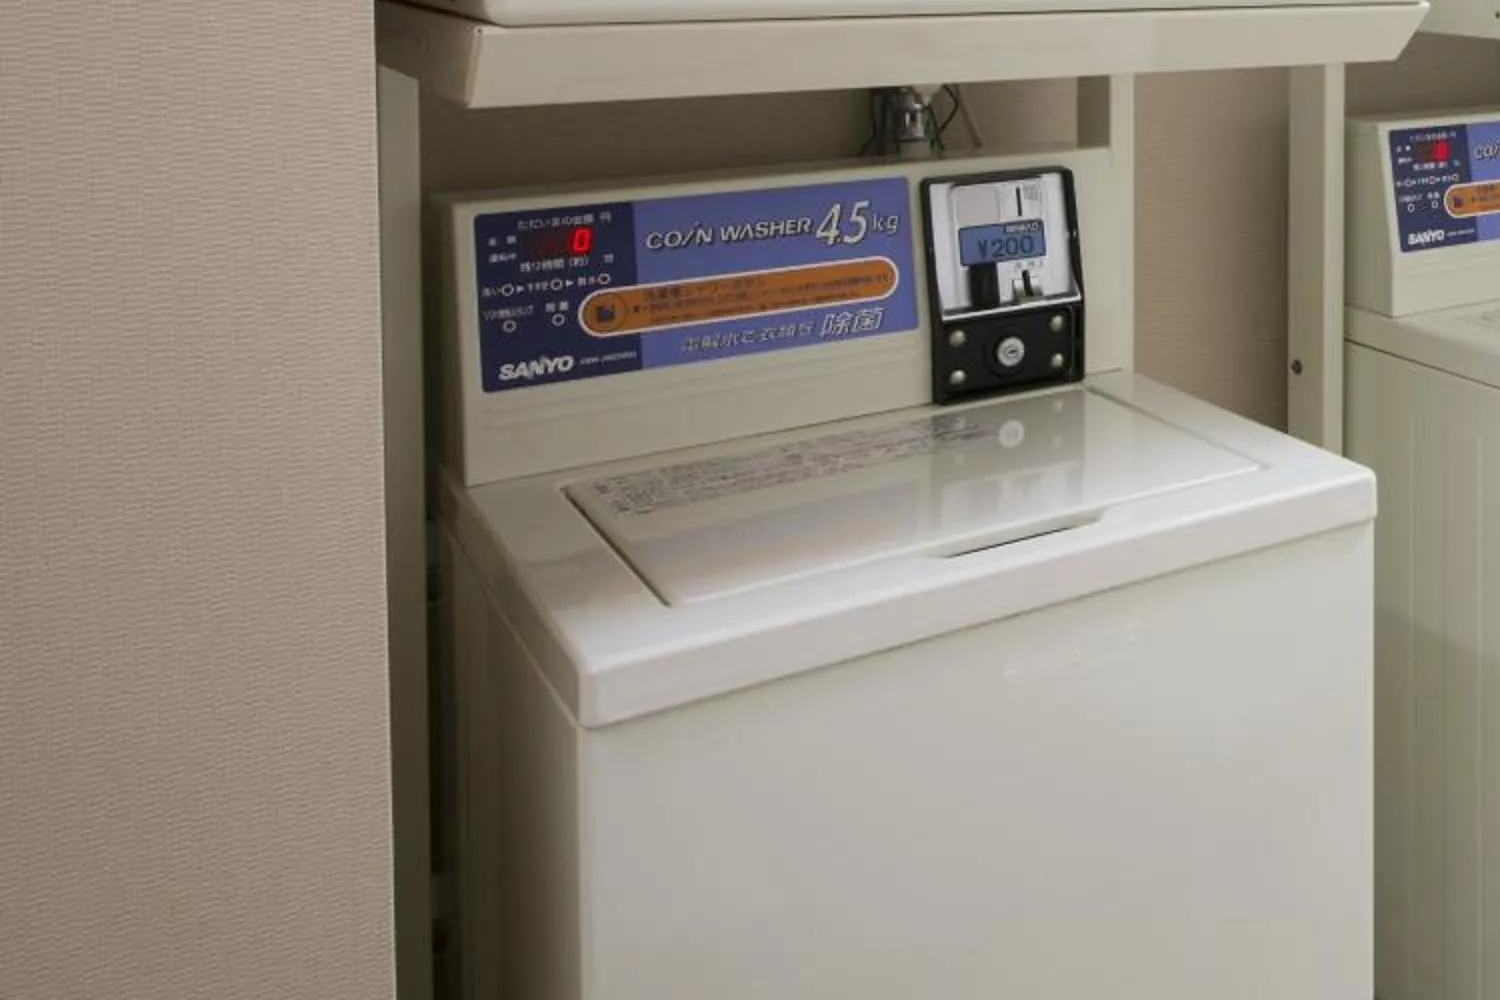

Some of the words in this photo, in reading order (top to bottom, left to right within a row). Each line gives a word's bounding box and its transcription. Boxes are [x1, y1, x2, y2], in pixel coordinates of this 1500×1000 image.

[573, 228, 590, 253] 0
[720, 216, 811, 244] WASHER
[1408, 229, 1445, 246] SANYO
[977, 235, 1034, 260] ¥200
[499, 356, 574, 381] SANYO
